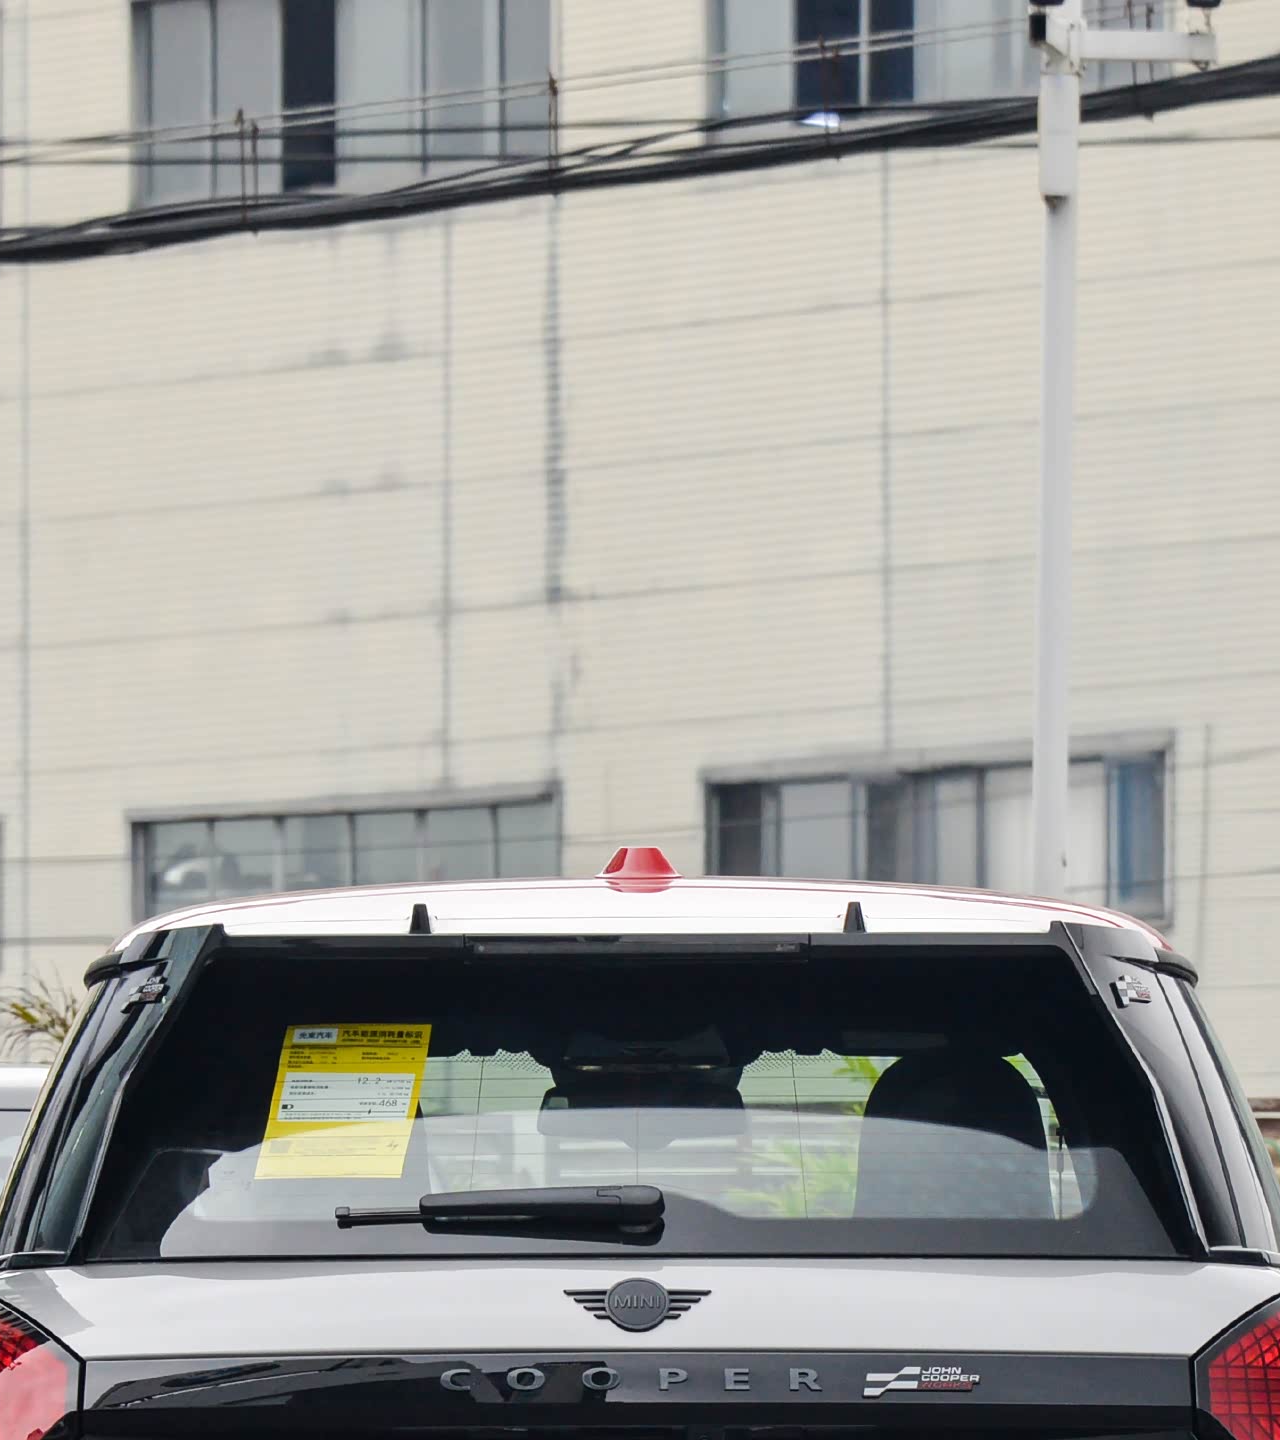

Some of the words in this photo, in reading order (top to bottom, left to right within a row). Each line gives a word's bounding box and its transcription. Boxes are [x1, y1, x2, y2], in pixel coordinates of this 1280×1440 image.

[613, 1294, 661, 1309] MINI
[921, 1366, 962, 1375] JOHN
[439, 1367, 823, 1393] COOPER
[921, 1374, 981, 1382] COOPER
